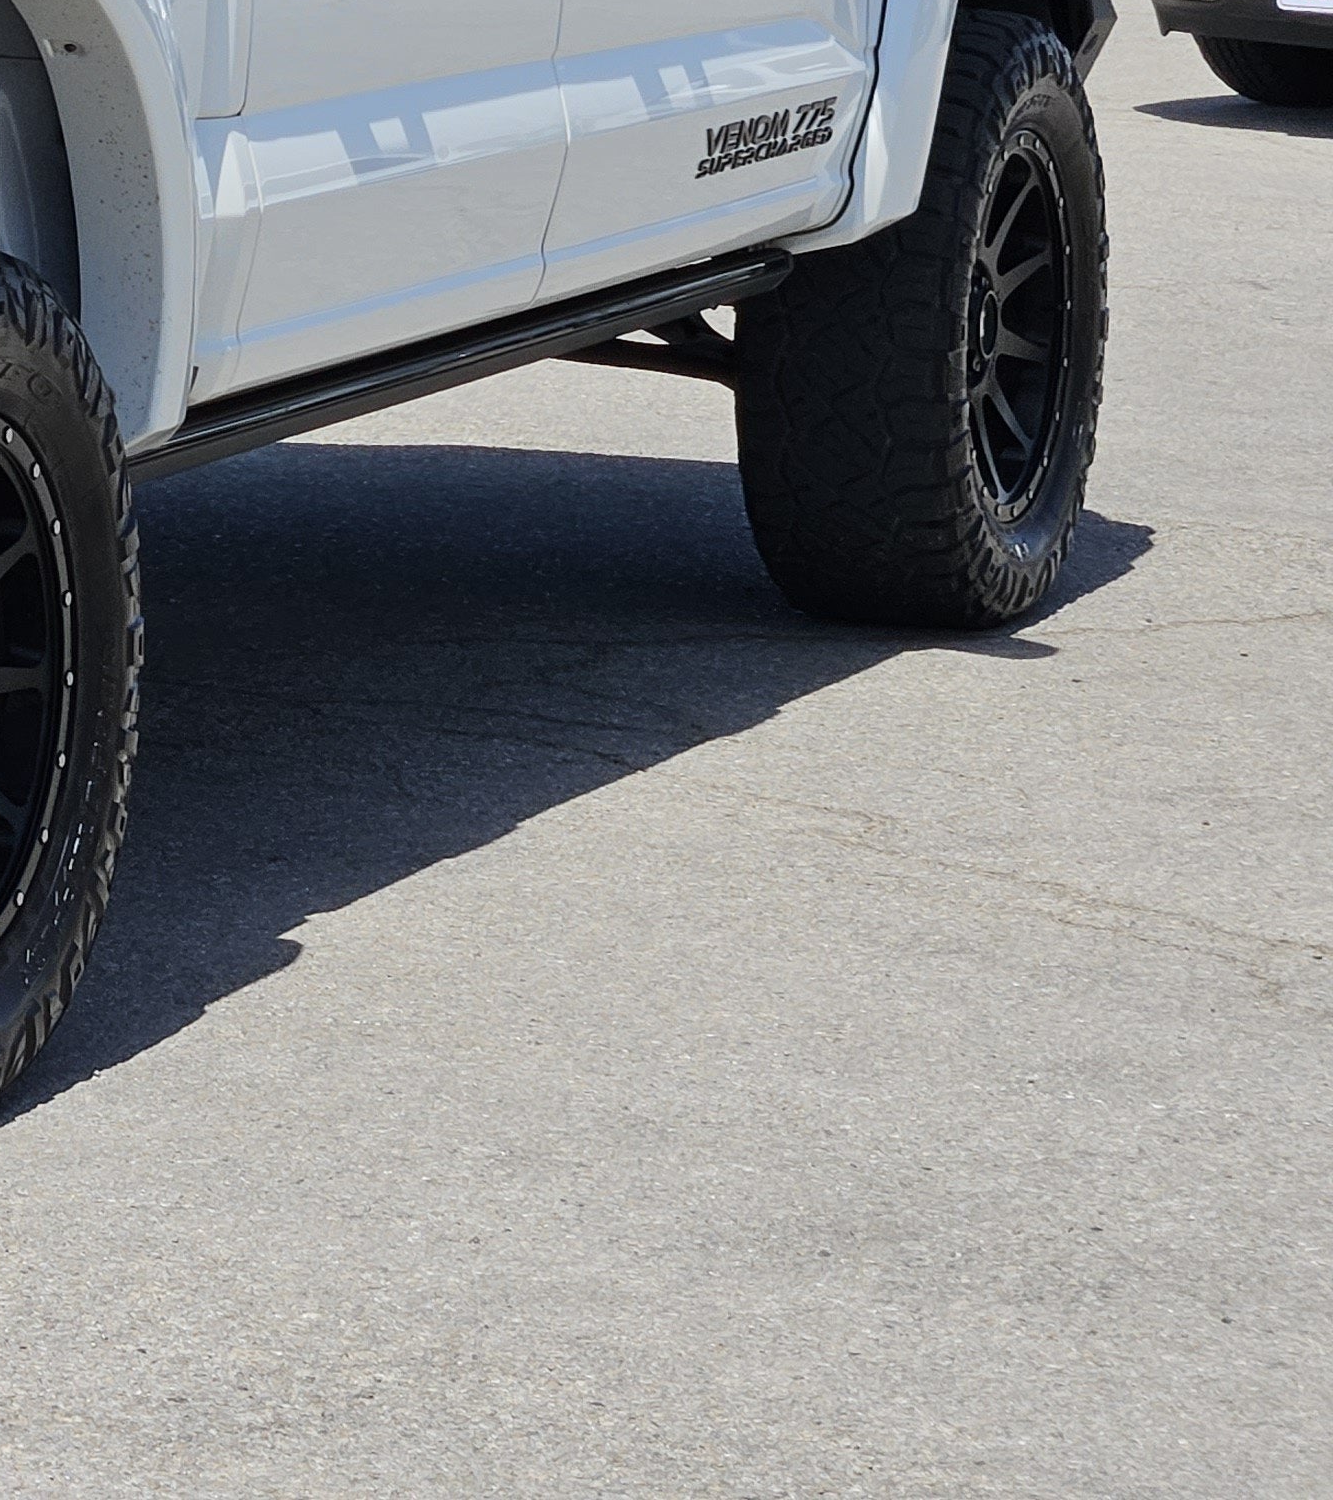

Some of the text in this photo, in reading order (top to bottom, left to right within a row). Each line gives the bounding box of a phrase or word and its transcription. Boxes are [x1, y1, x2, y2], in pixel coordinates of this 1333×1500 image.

[695, 126, 834, 179] SUPERCHARGED
[706, 97, 837, 157] VENOM 775
